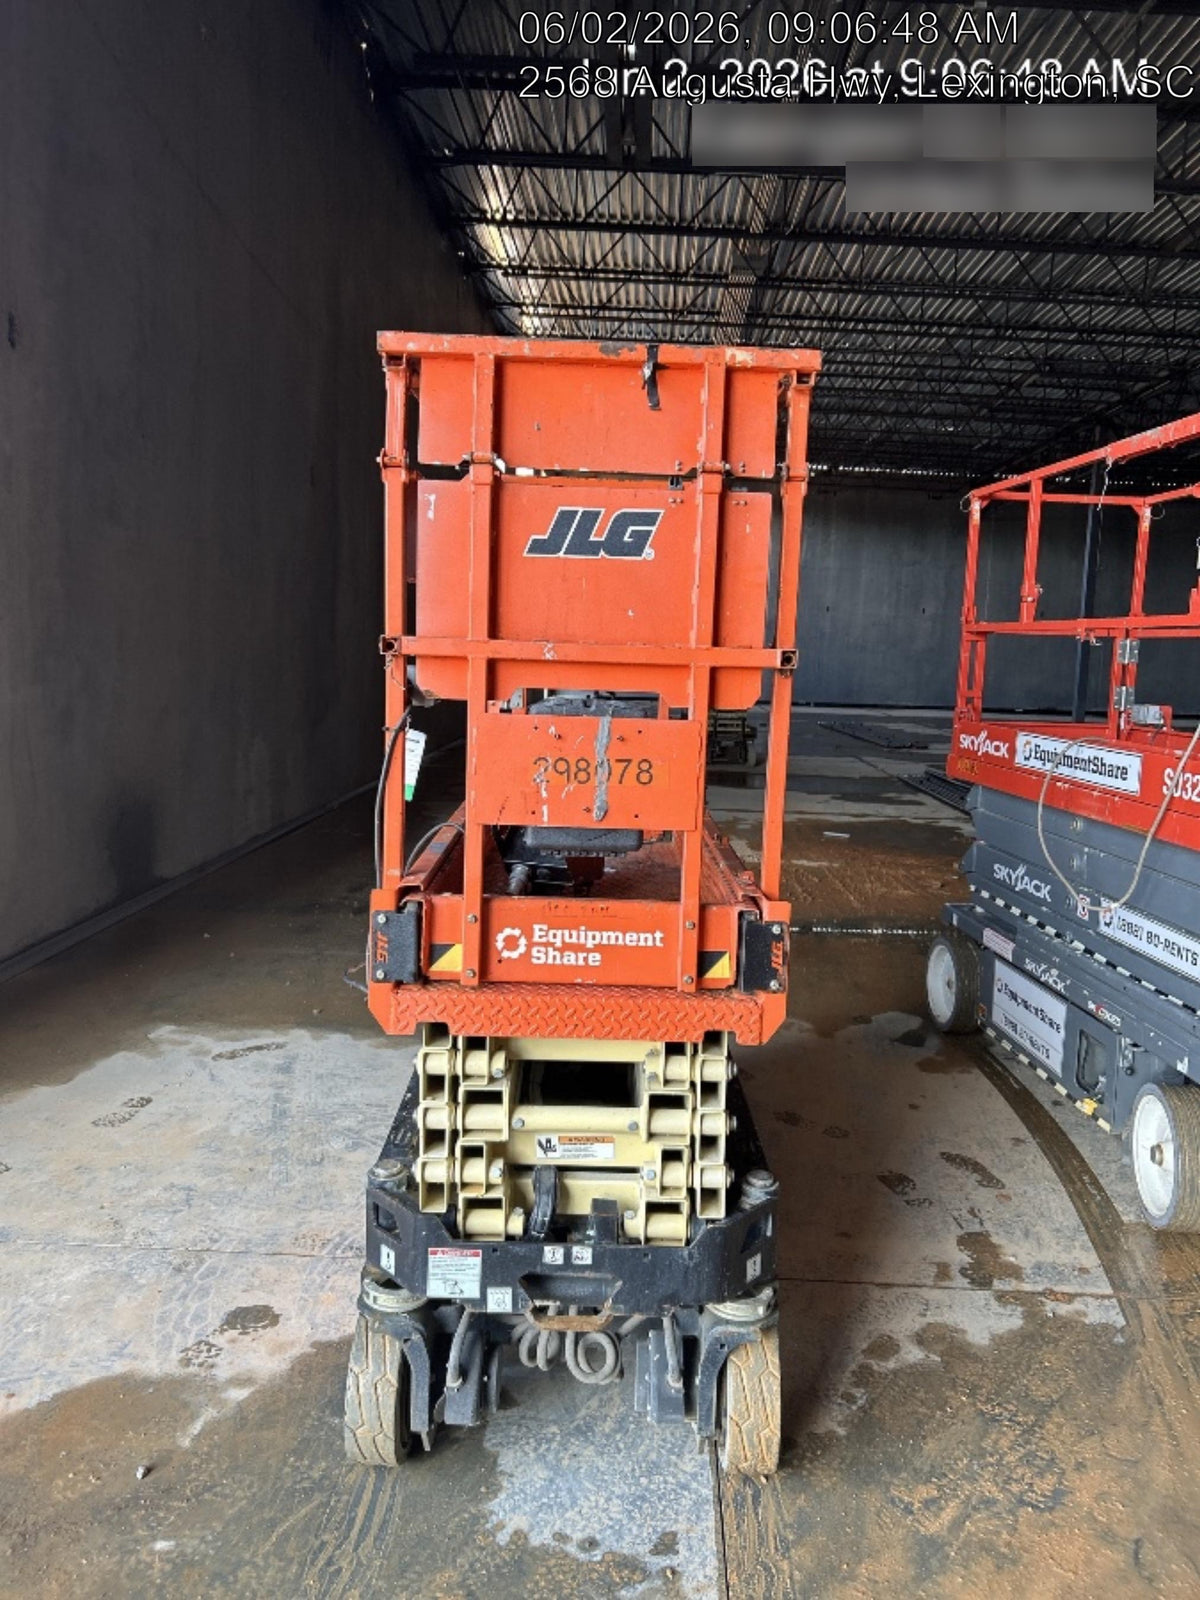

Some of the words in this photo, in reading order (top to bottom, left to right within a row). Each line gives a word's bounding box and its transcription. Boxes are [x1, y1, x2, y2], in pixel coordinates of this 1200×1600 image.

[523, 506, 665, 560] JLG
[959, 730, 1009, 760] SKYJACK
[1034, 744, 1128, 781] EquipmentShare
[993, 863, 1052, 902] SKYJACK
[376, 932, 389, 964] JLG
[532, 924, 664, 949] Equipment
[531, 946, 602, 967] Share
